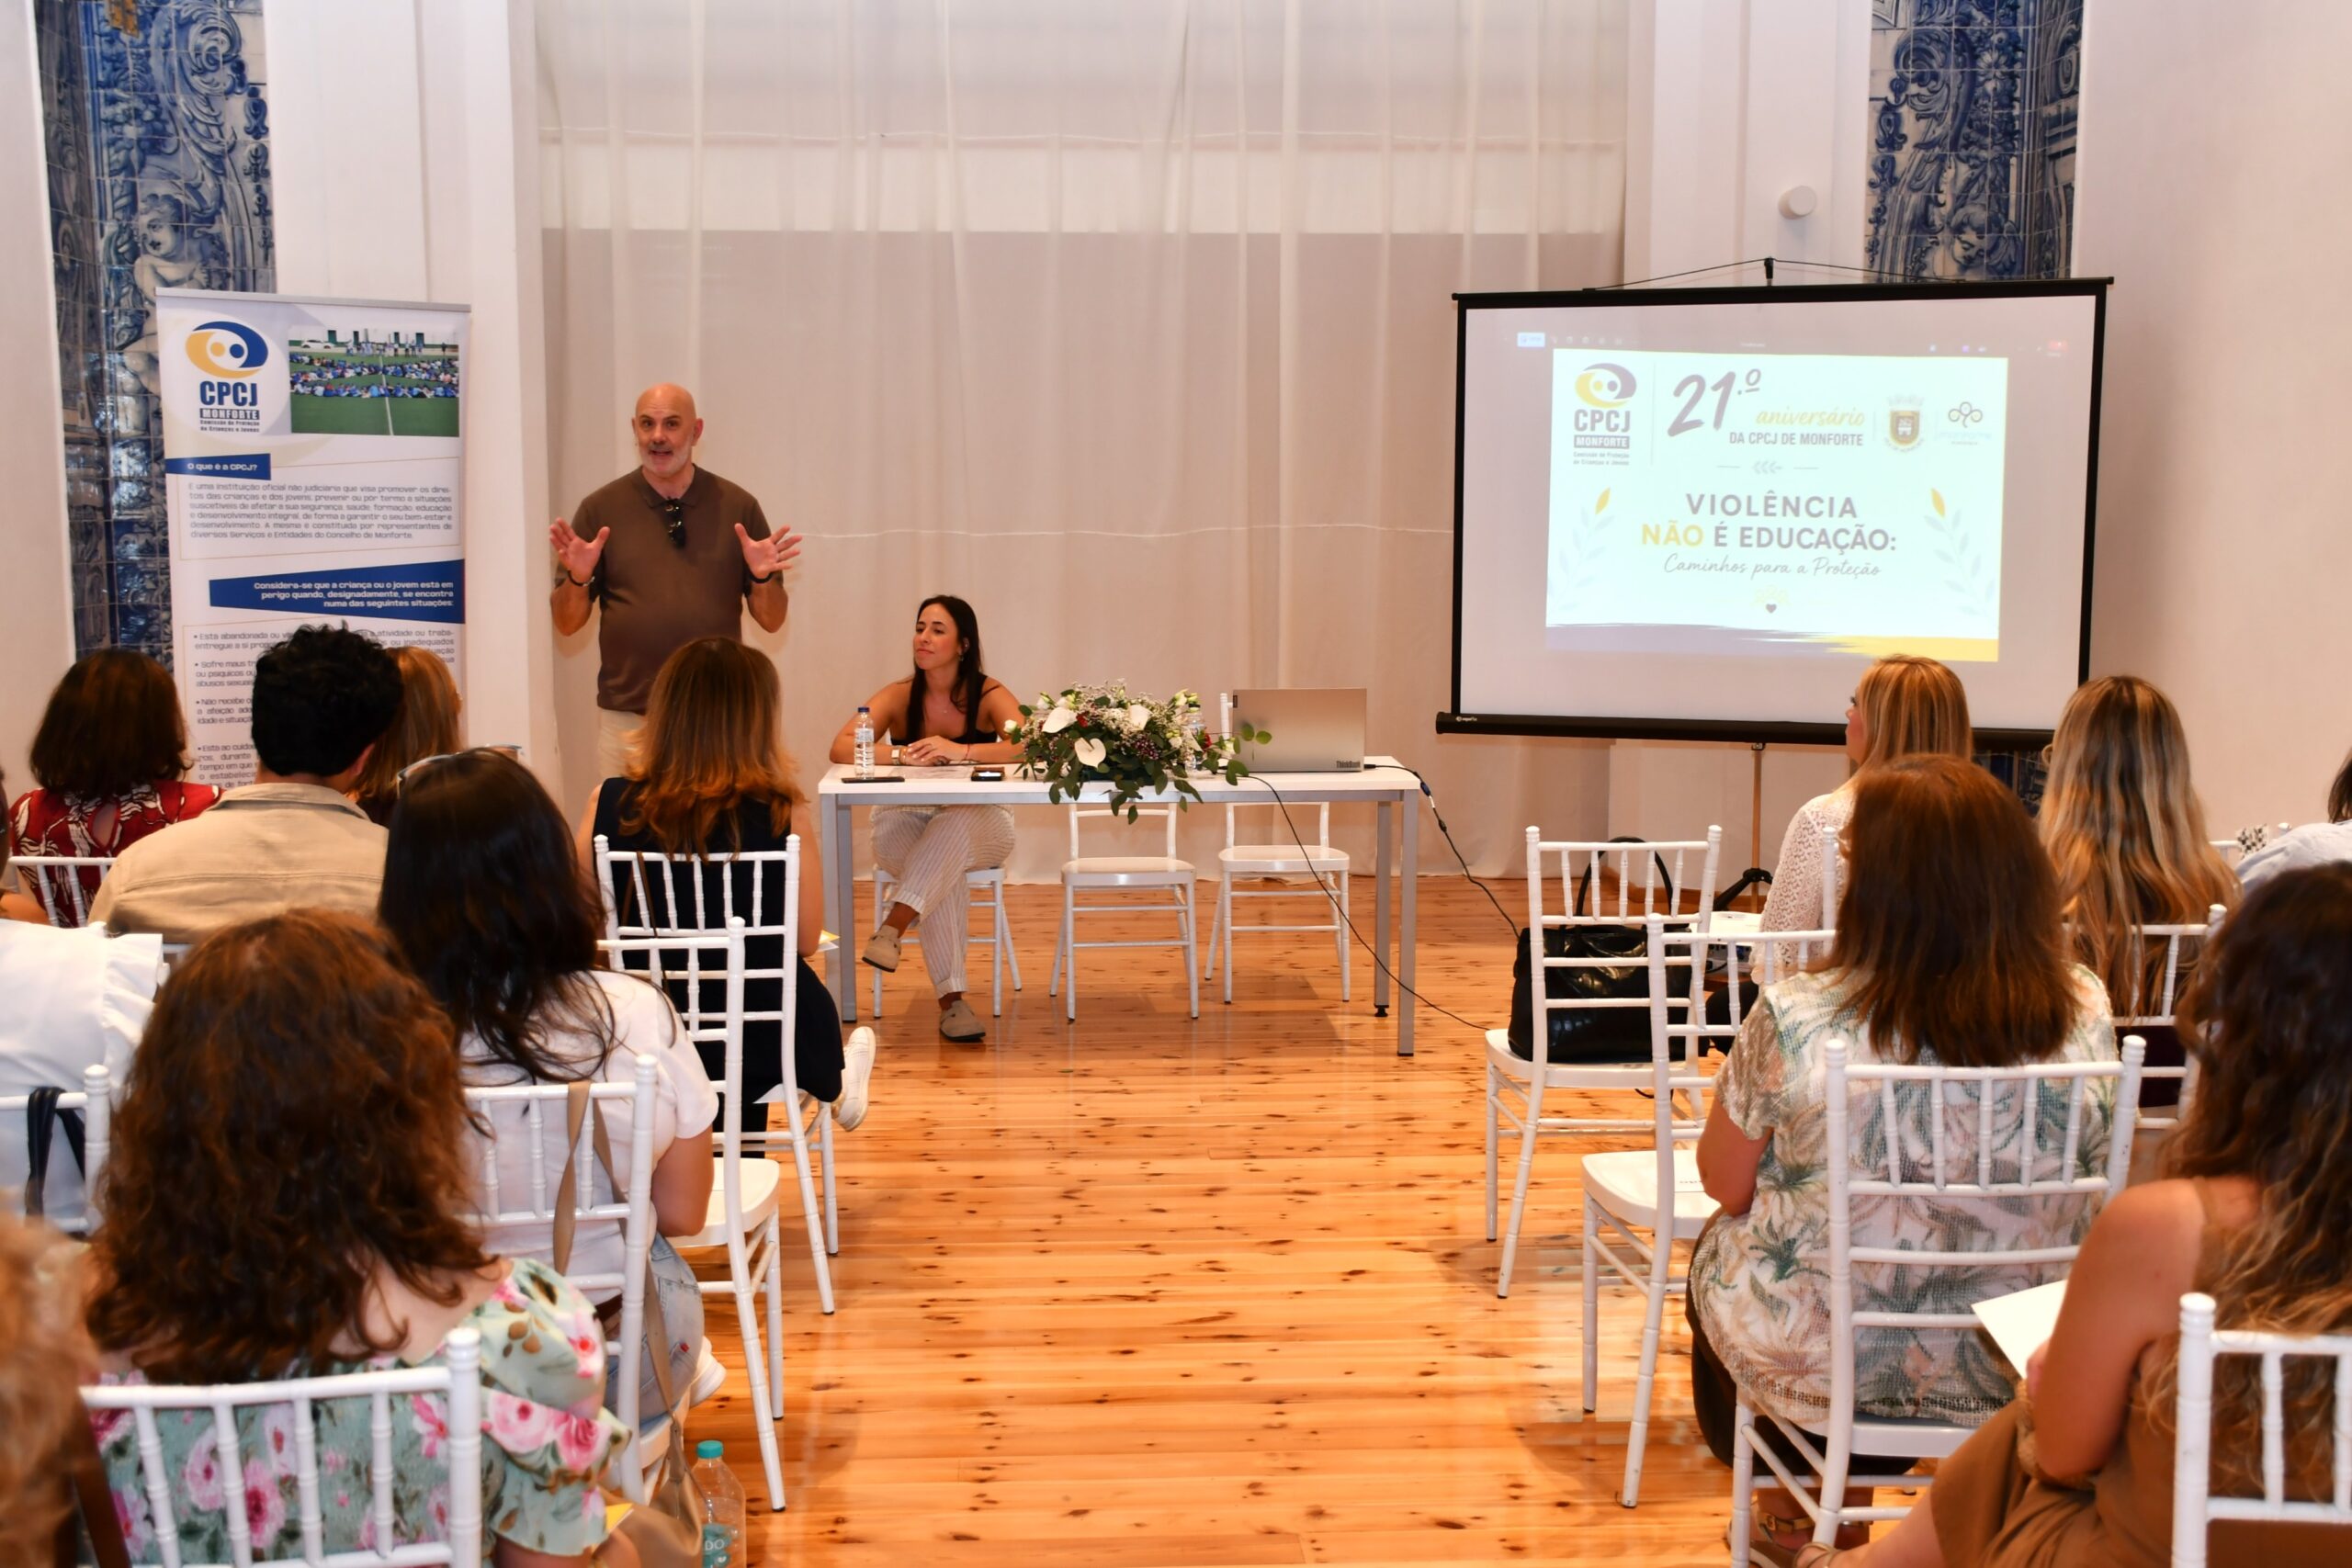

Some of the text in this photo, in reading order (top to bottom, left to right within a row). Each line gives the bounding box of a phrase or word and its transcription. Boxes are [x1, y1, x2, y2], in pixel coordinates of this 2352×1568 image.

[199, 380, 258, 407] CPCJ
[201, 409, 258, 420] MONFORTE
[1574, 409, 1631, 433] CPCJ
[1755, 405, 1865, 427] aniversário
[1576, 436, 1627, 447] MONFORTE
[1729, 432, 1863, 446] DA CPCJ DE MONFORTE
[196, 463, 213, 471] que
[1686, 490, 1858, 519] VIOLÊNCIA
[1641, 520, 1896, 556] NÃO É EDUCAÇÃO:
[1664, 553, 1882, 581] Caminhos para a Proteção
[314, 582, 331, 591] que
[338, 581, 372, 590] criança
[393, 581, 419, 591] jovem
[261, 592, 290, 600] perigo
[367, 600, 410, 608] seguintes
